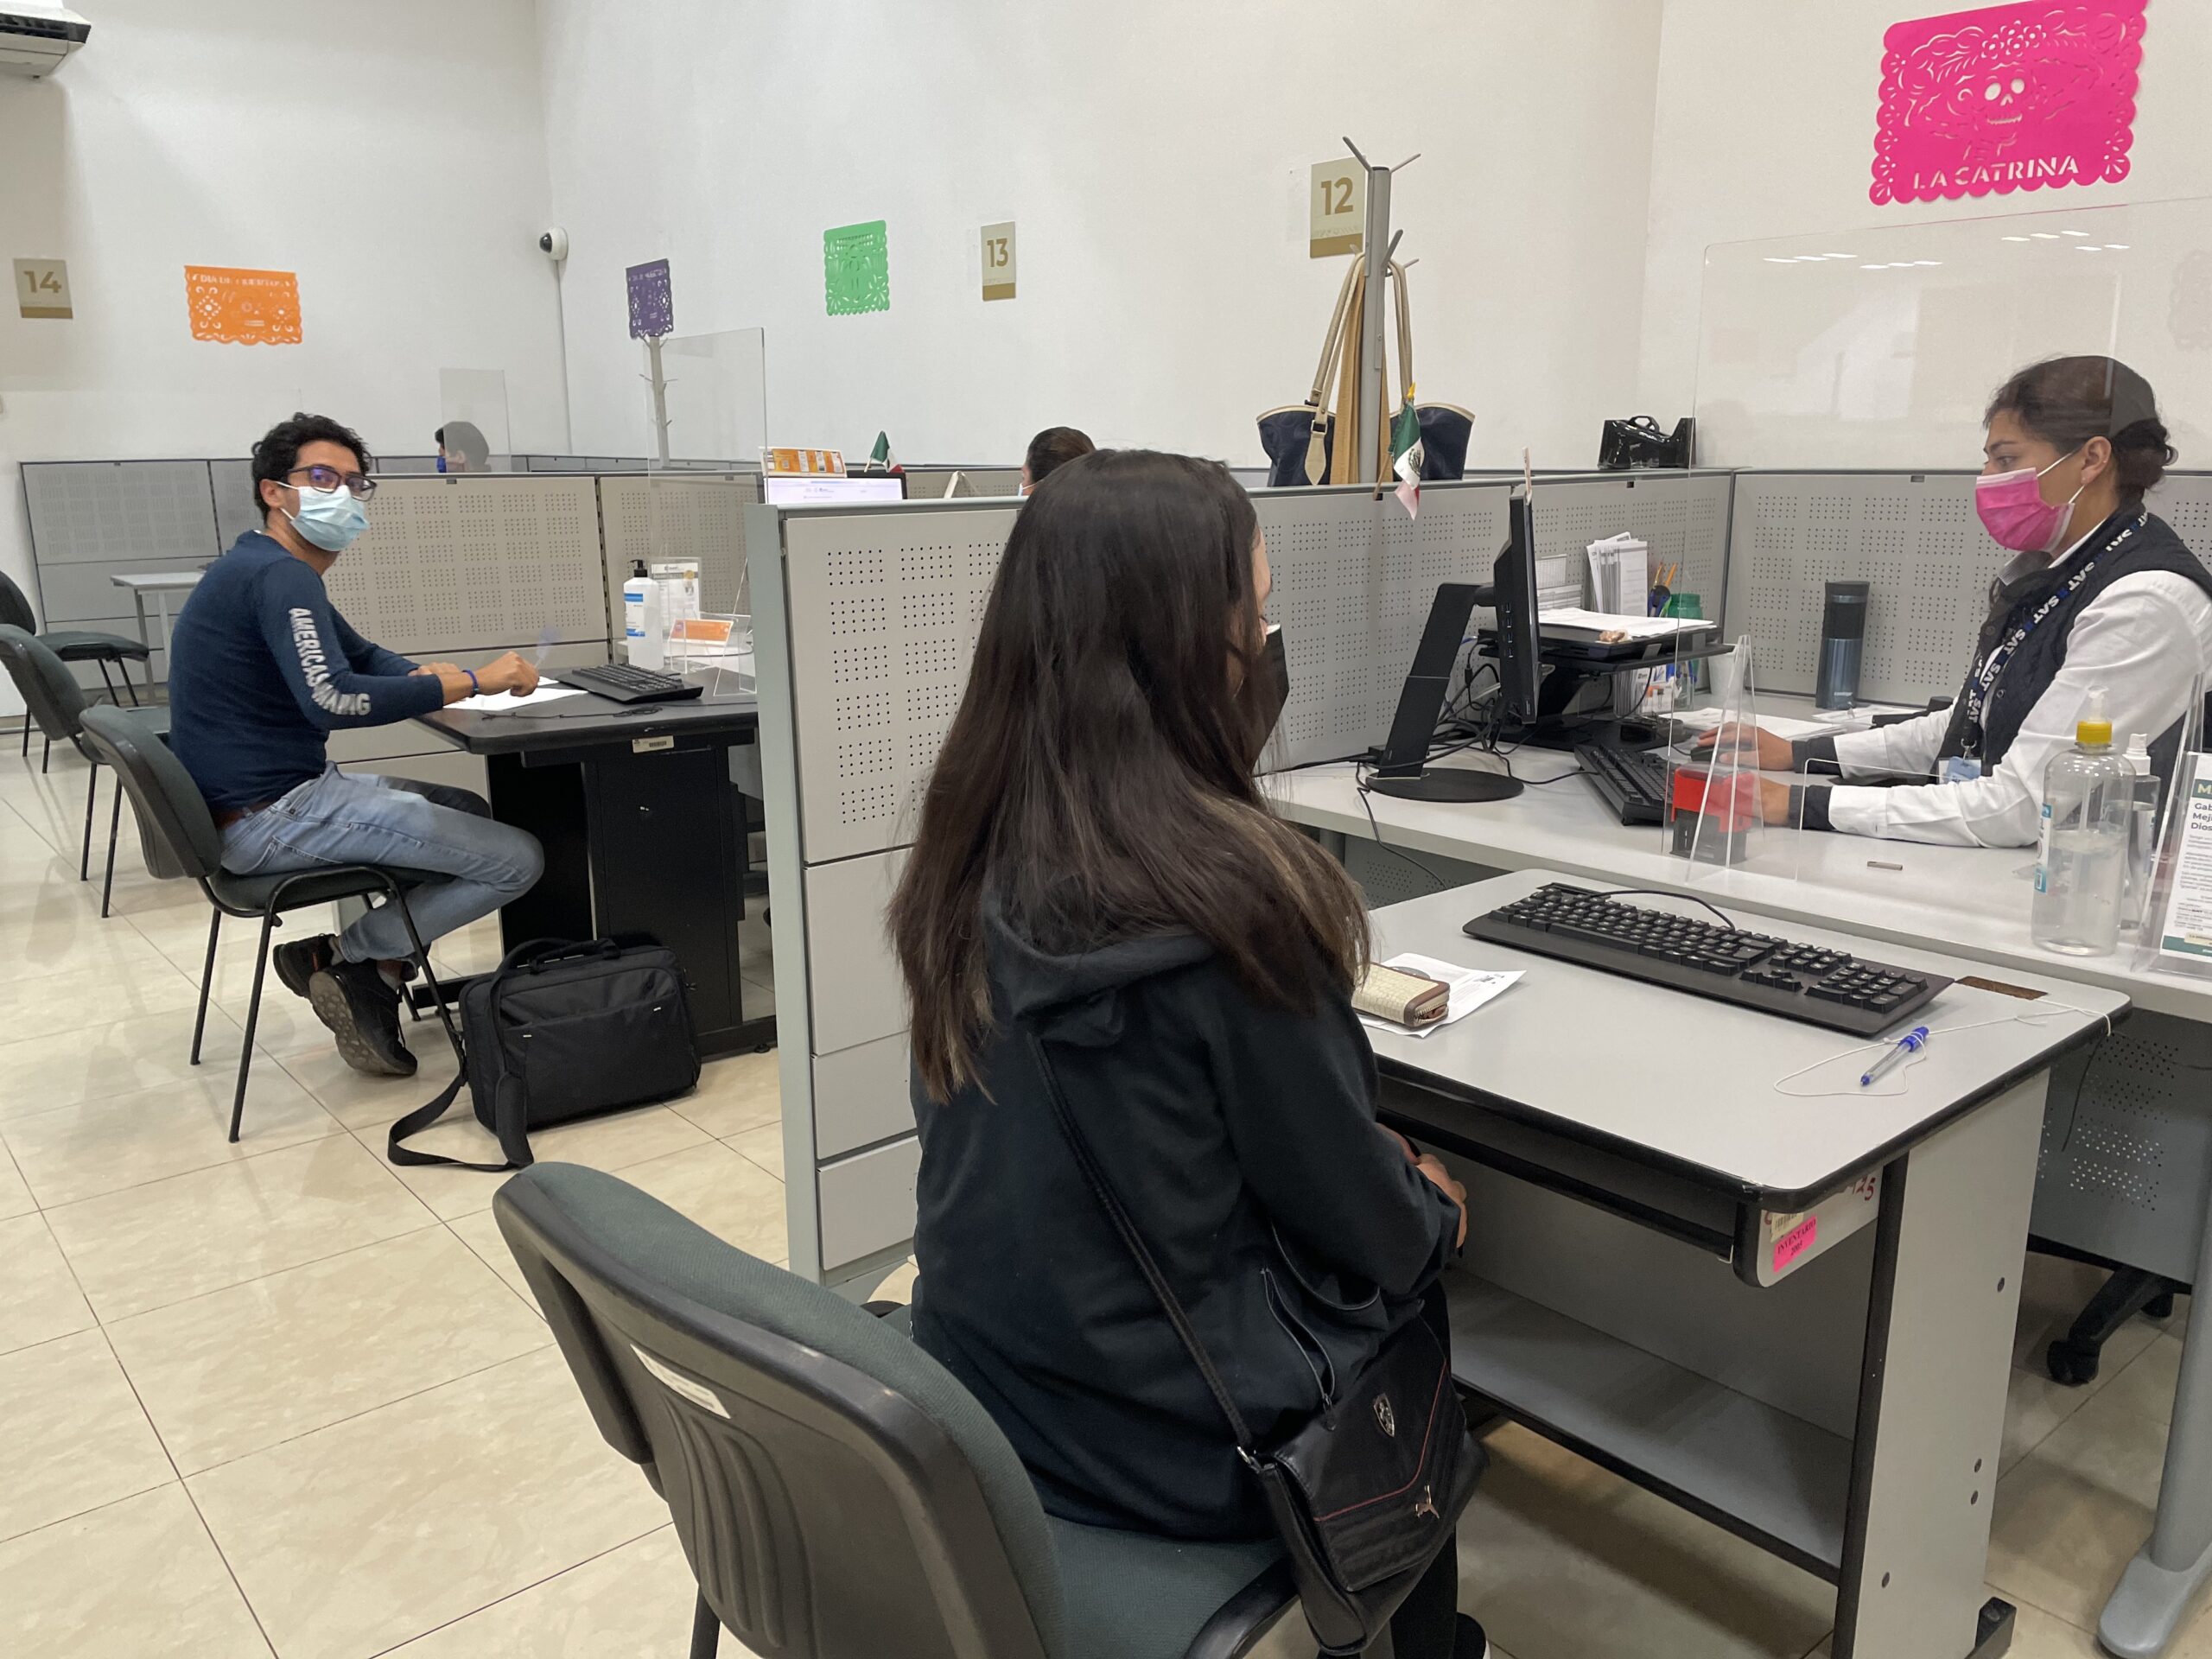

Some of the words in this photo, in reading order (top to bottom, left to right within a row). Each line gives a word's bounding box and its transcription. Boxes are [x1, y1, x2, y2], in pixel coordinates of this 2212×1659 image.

[1913, 169, 1948, 189] LA
[1955, 155, 2079, 186] CATRINA
[1320, 176, 1354, 216] 12
[986, 238, 1009, 268] 13
[23, 270, 62, 294] 14
[2068, 562, 2095, 591] SAT
[2032, 595, 2060, 624] SAT
[2004, 628, 2026, 655] SAT
[1981, 663, 2001, 691] SAT
[1969, 697, 1982, 723] SAT
